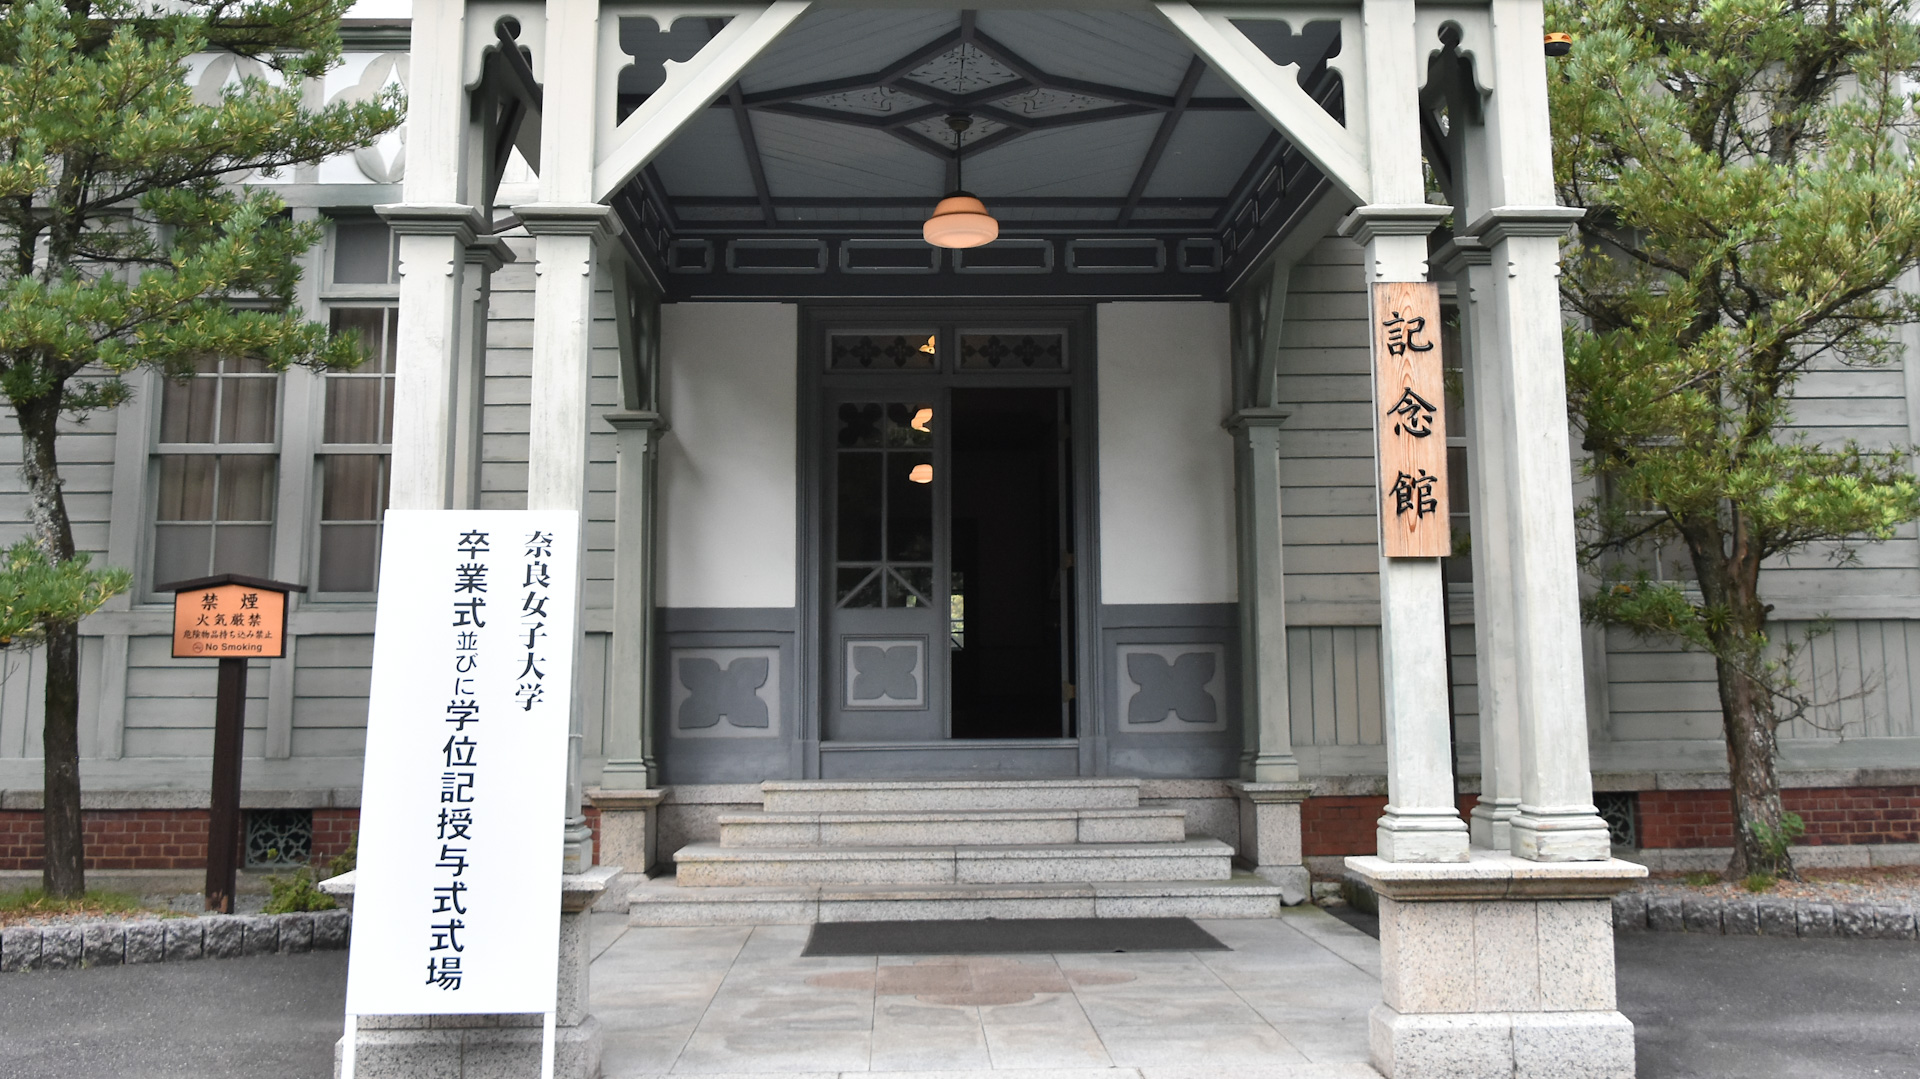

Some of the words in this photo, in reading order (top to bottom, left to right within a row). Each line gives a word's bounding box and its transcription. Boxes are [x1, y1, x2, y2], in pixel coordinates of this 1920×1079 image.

[1383, 312, 1437, 519] 記念館
[183, 629, 272, 639] 危険物品持ち込み禁止
[196, 613, 261, 627] 火気厳禁
[205, 643, 218, 651] No
[221, 643, 262, 652] Smoking
[515, 530, 553, 712] 奈良女子大学
[425, 529, 490, 991] 卒業式並びに学位記授与式式場
